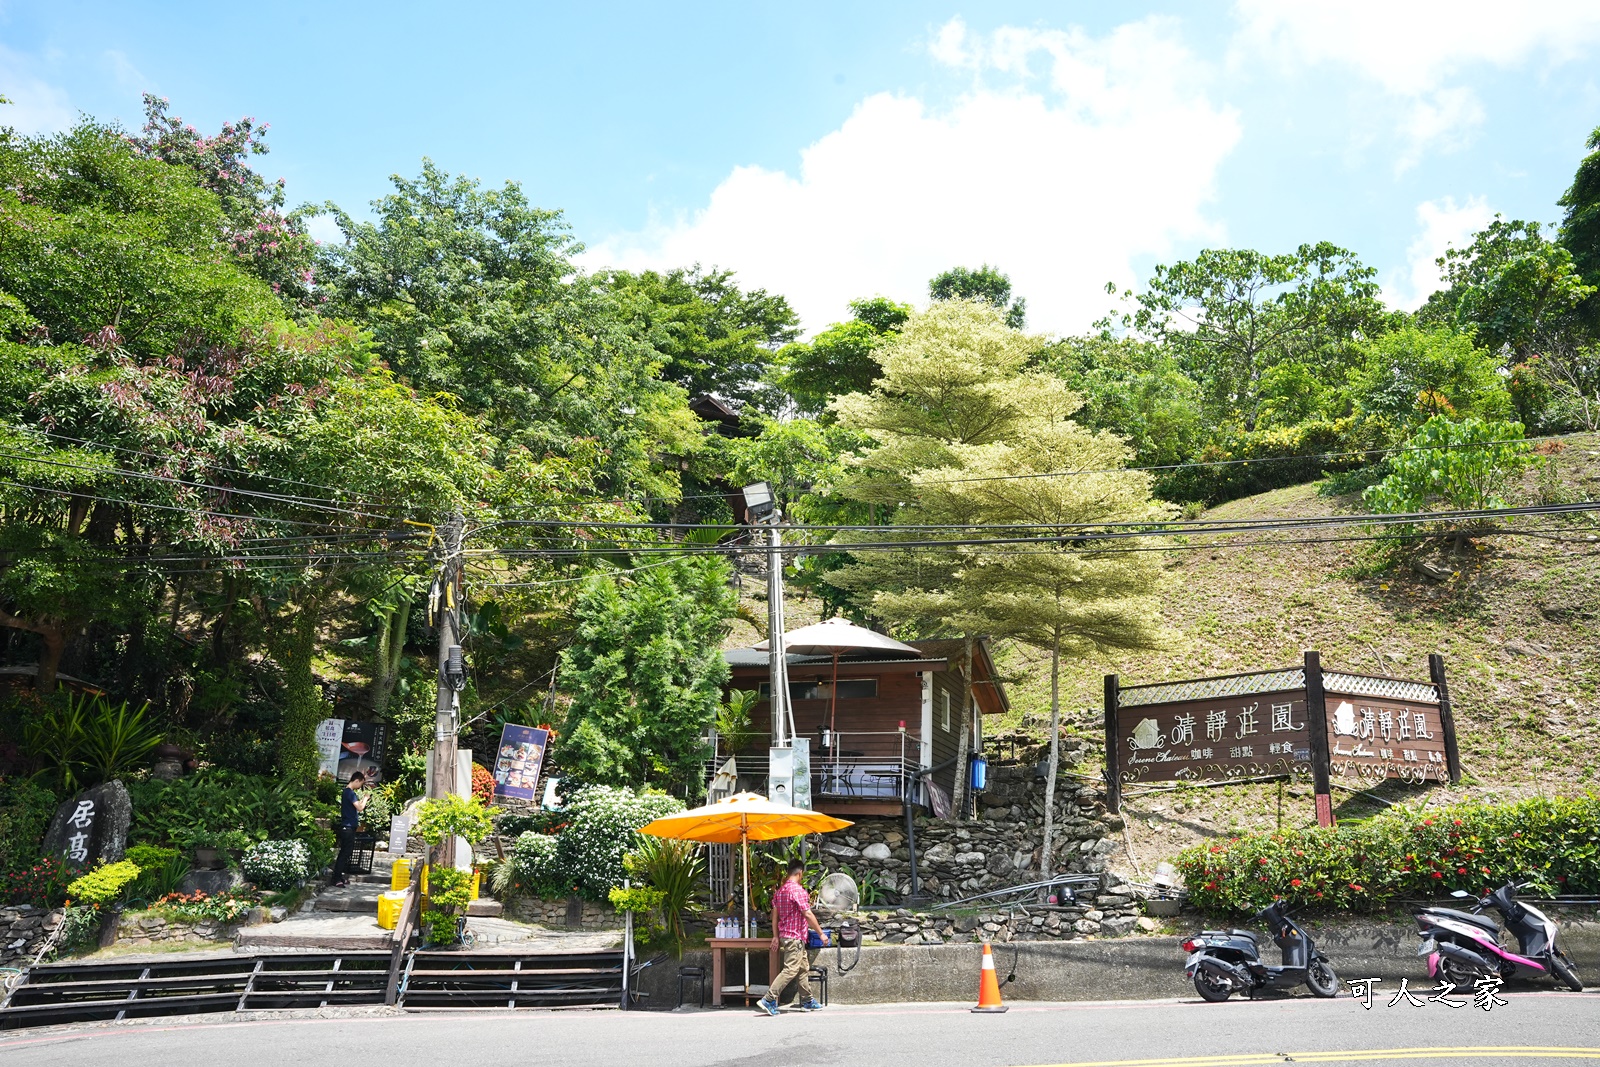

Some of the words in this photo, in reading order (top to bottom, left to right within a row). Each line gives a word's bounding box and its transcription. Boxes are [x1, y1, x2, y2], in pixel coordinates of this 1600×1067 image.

[1190, 747, 1214, 760] 咖啡
[1229, 745, 1254, 758] 甜點
[1269, 740, 1294, 755] 輕食
